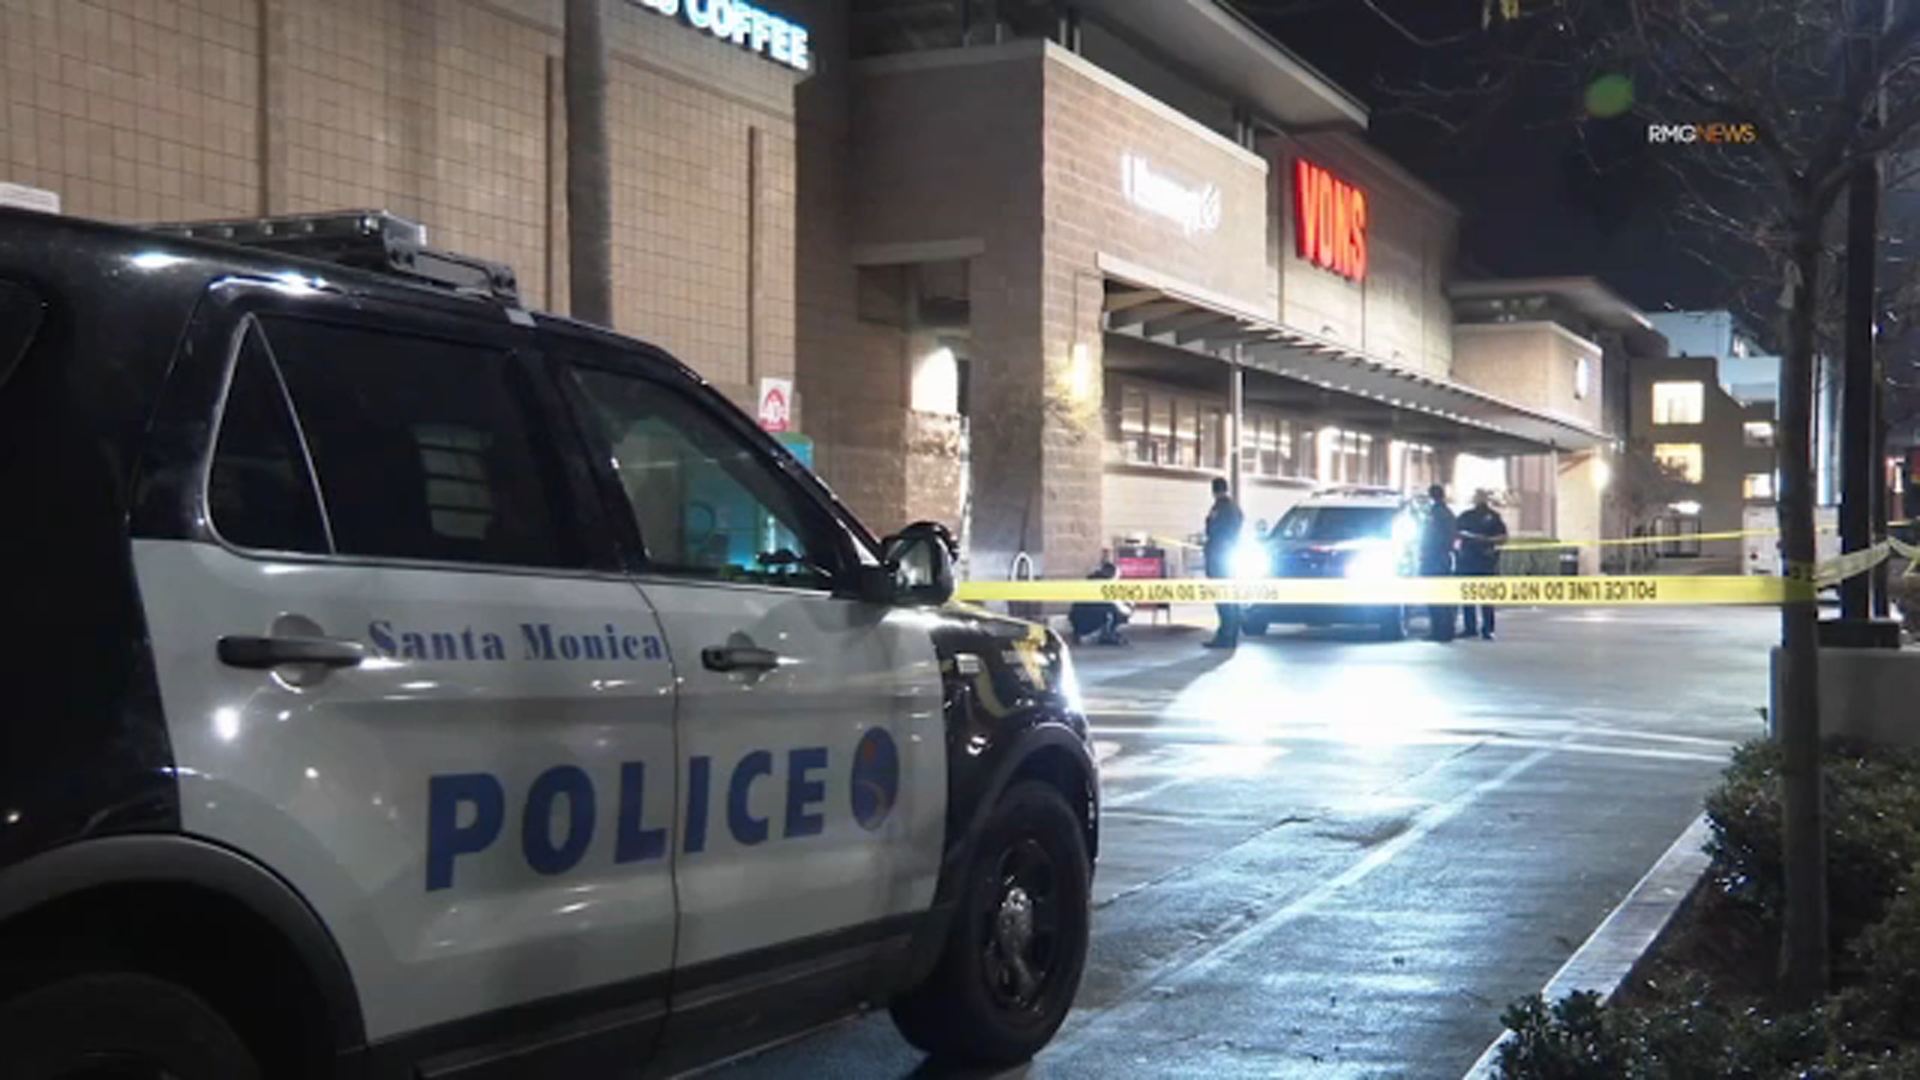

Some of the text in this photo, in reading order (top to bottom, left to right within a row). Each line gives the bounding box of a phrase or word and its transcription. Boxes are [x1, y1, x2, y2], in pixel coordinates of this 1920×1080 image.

[684, 0, 809, 70] COFFEE
[1297, 158, 1367, 283] VONS
[1101, 584, 1144, 600] CROSS
[1148, 584, 1174, 600] NOT
[1176, 584, 1195, 600] DO
[1460, 580, 1657, 600] POLICE LINE DO NOT CROSS
[367, 619, 663, 662] Santa Monica
[426, 746, 829, 892] POLICE
